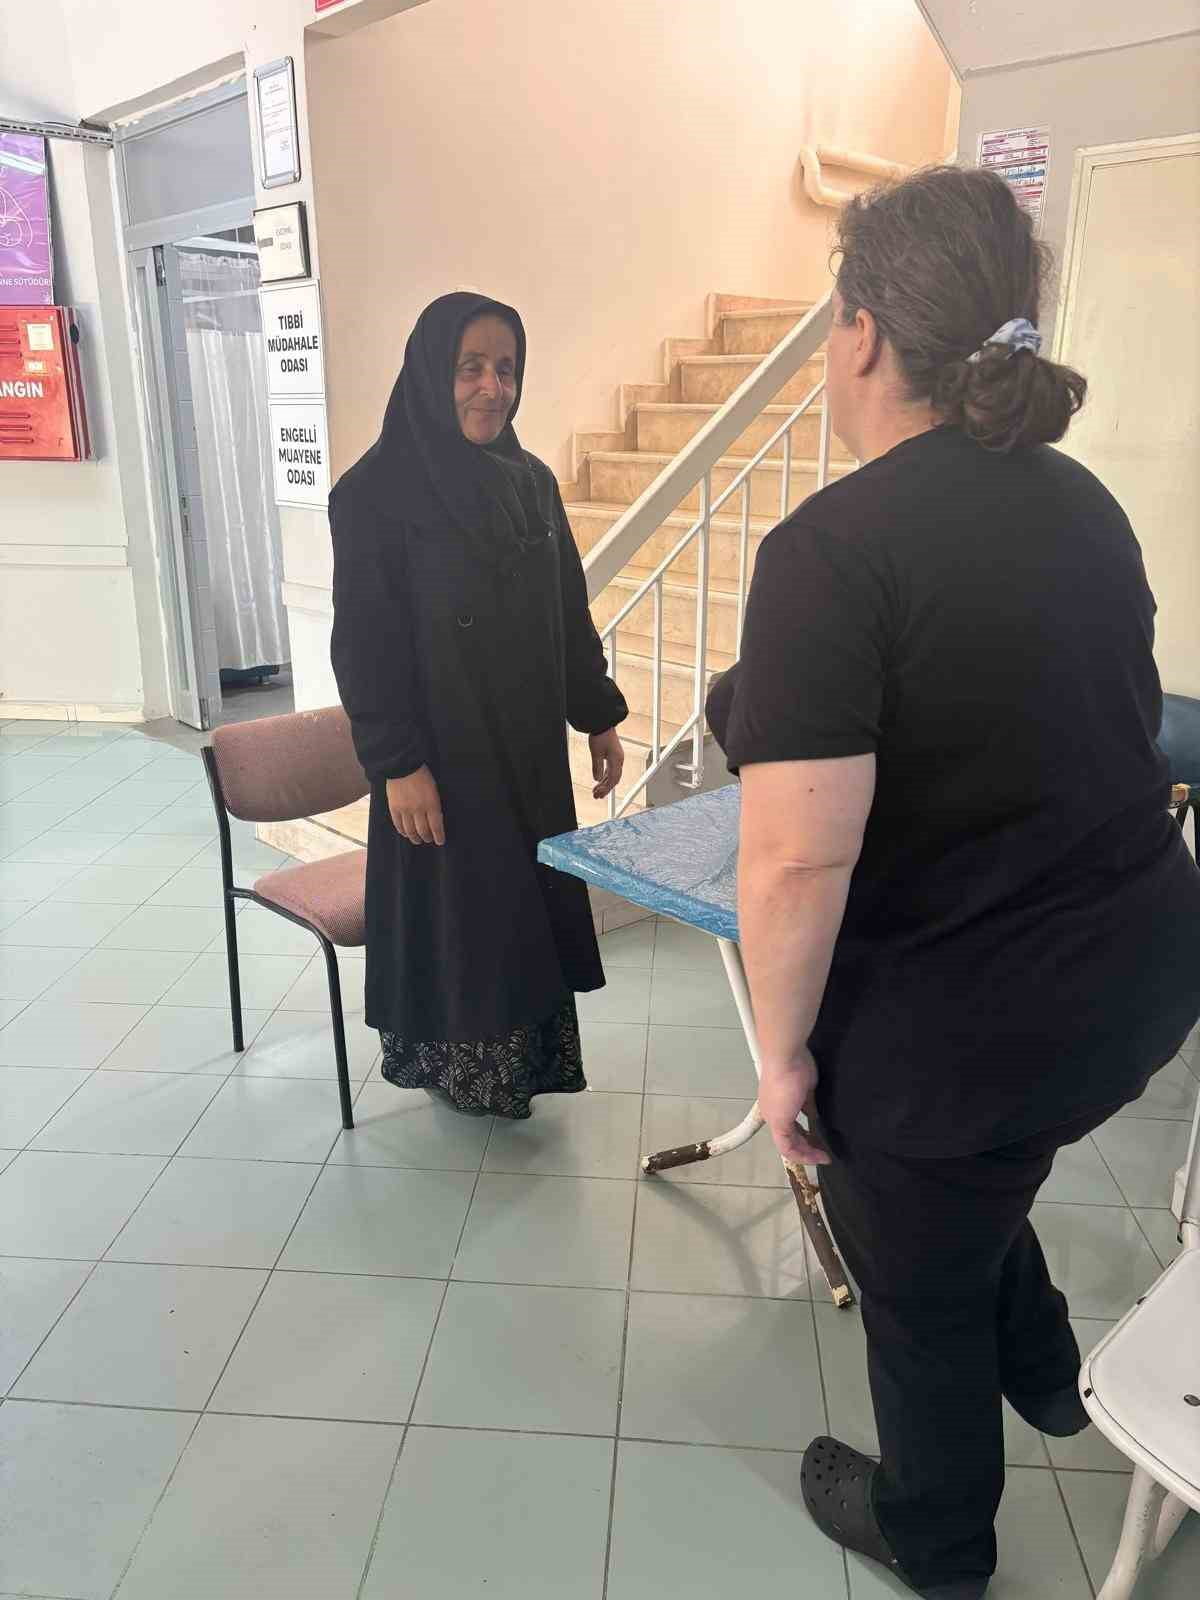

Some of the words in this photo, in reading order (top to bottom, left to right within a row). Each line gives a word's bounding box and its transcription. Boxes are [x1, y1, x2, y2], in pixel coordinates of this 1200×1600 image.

[278, 310, 303, 330] TIBBİ
[268, 335, 319, 352] MÜDAHALE
[280, 358, 308, 373] ODASI
[280, 424, 317, 443] ENGELLİ
[278, 447, 322, 464] MUAYENE
[286, 468, 315, 486] ODASI
